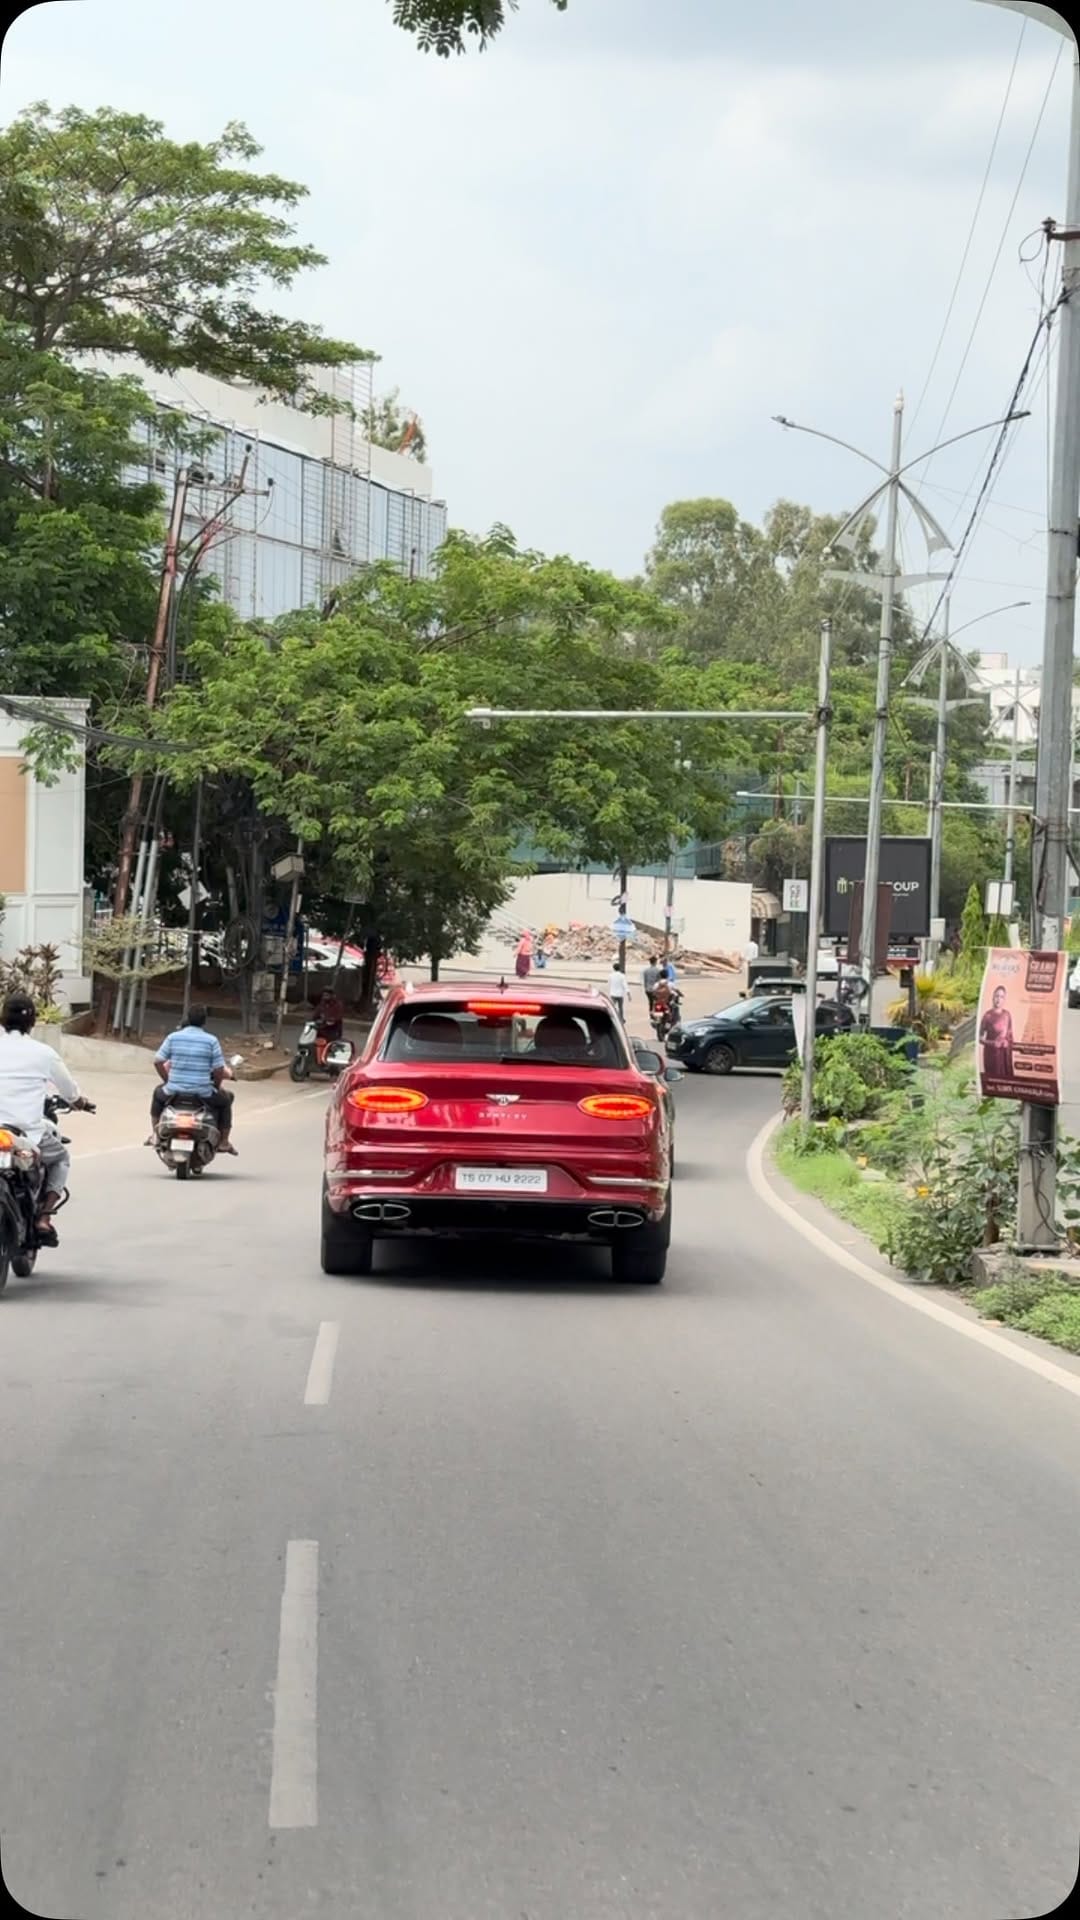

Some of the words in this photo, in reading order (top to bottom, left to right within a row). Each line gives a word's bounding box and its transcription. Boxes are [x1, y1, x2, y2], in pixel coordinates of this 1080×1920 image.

[462, 1174, 475, 1182] TS
[479, 1174, 492, 1183] 07
[514, 1175, 541, 1184] 2222
